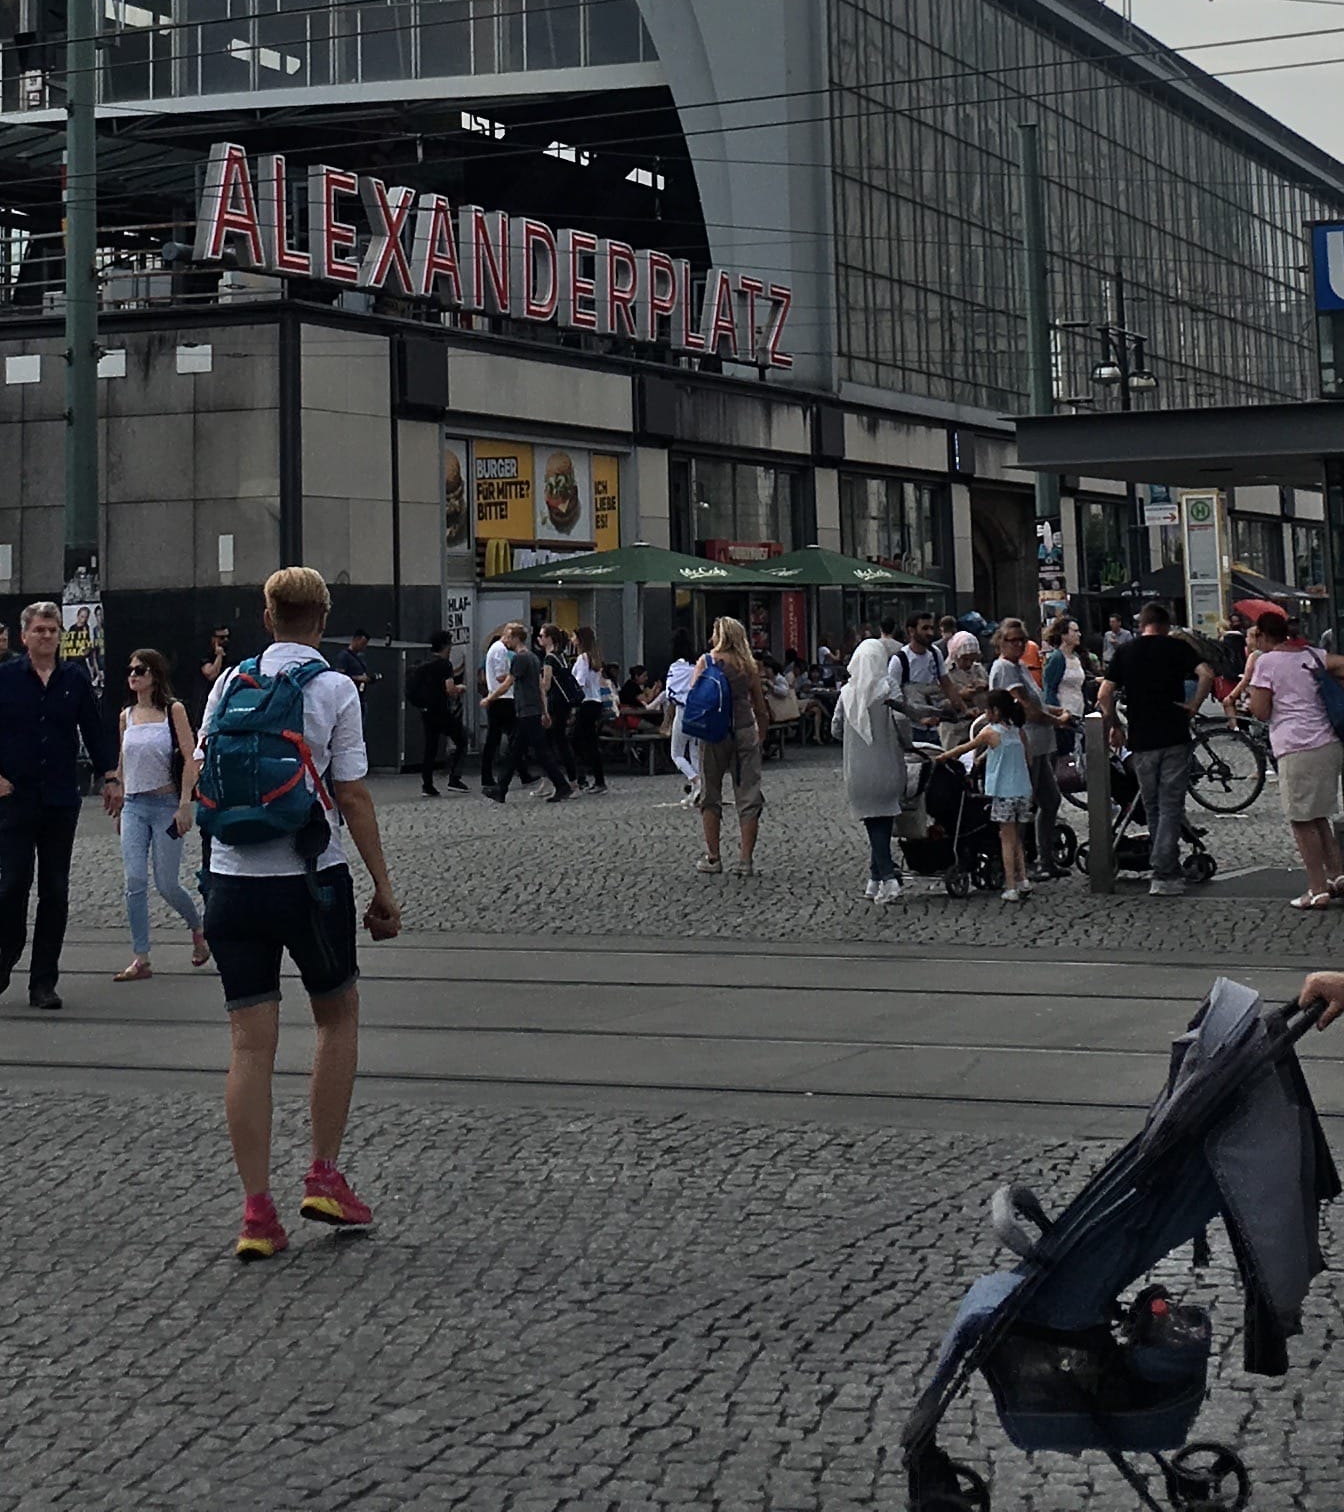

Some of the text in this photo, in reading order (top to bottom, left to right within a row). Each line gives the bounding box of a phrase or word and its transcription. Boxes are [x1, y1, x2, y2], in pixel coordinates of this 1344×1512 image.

[192, 141, 794, 370] ALEXANDERPLATZ
[475, 458, 518, 478] BURGER
[476, 480, 530, 502] FÜR MITTE?
[594, 480, 608, 494] ICH
[477, 501, 508, 520] BITTE!
[594, 496, 616, 511] LIEBE
[596, 514, 608, 529] ES!
